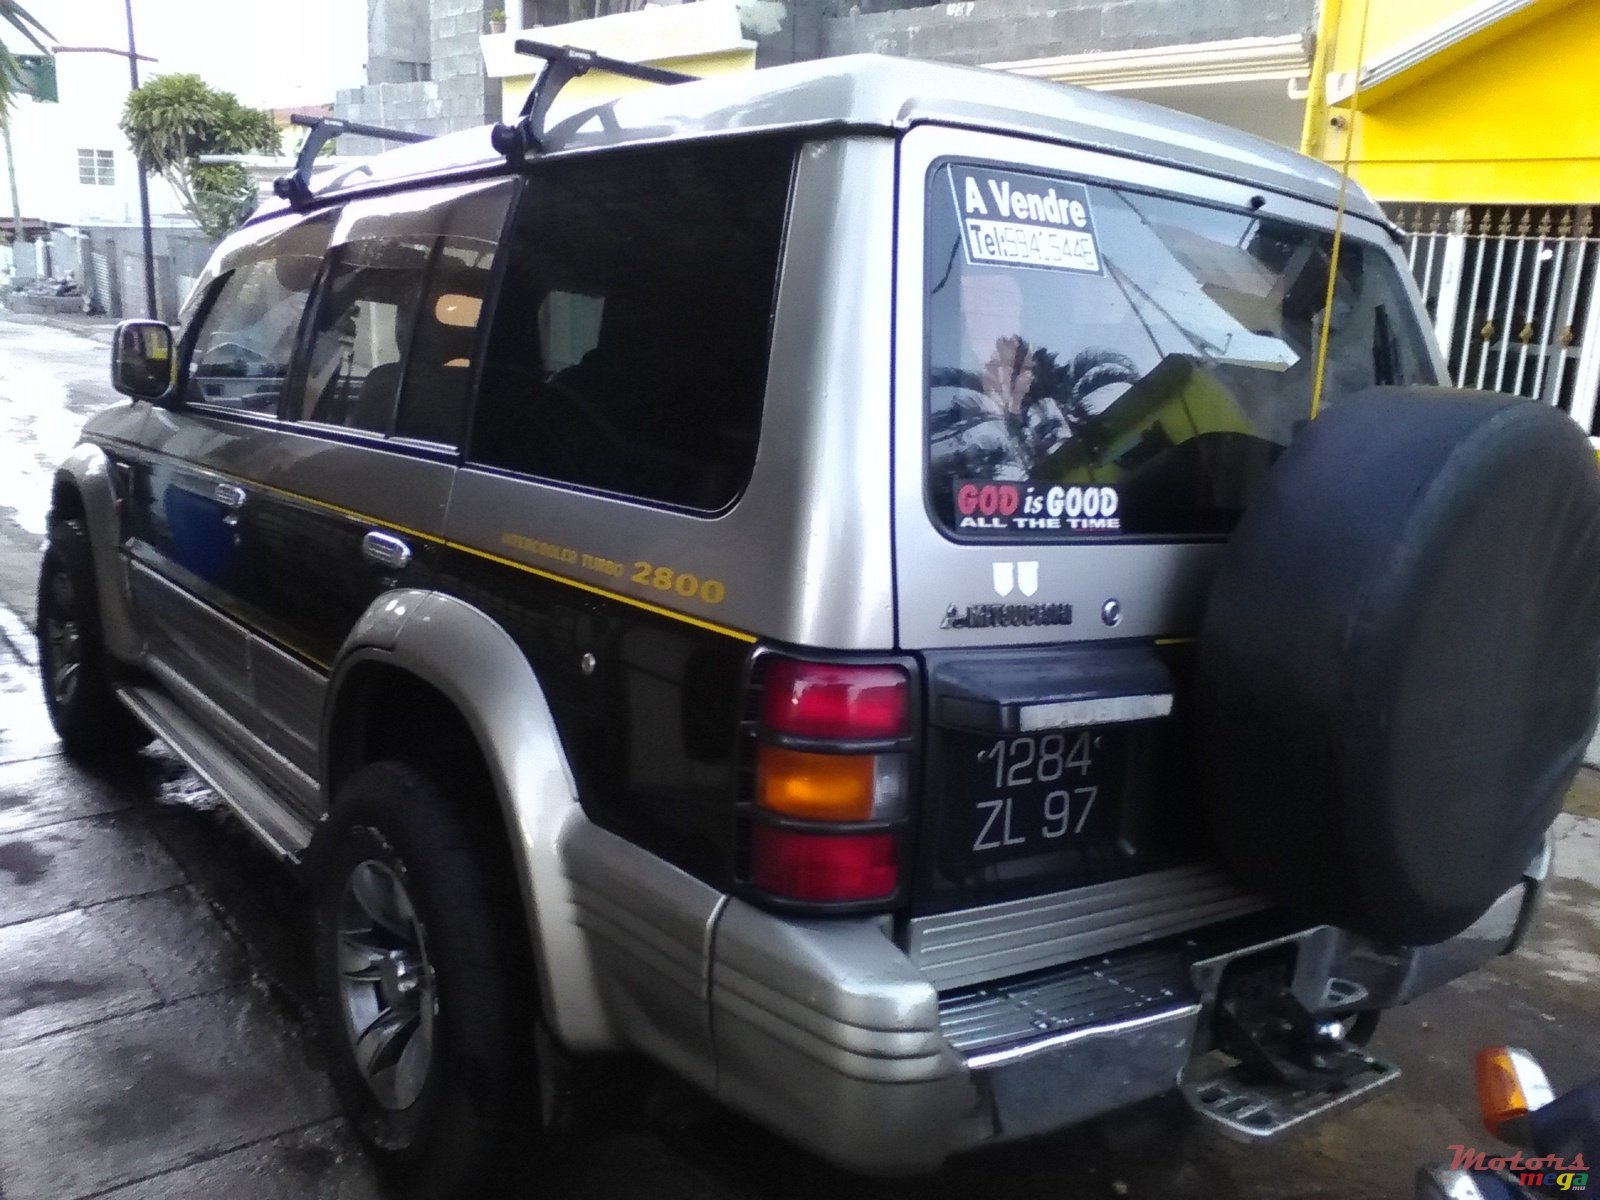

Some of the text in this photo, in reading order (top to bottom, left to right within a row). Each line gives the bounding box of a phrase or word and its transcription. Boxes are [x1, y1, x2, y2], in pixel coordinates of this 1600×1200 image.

[965, 176, 1087, 228] A Vendre
[957, 483, 1119, 517] GOD is GOOD
[960, 516, 1121, 529] ALL THE TIME
[631, 560, 726, 604] 2800
[988, 731, 1092, 788] 1284
[973, 785, 1099, 851] ZL 97
